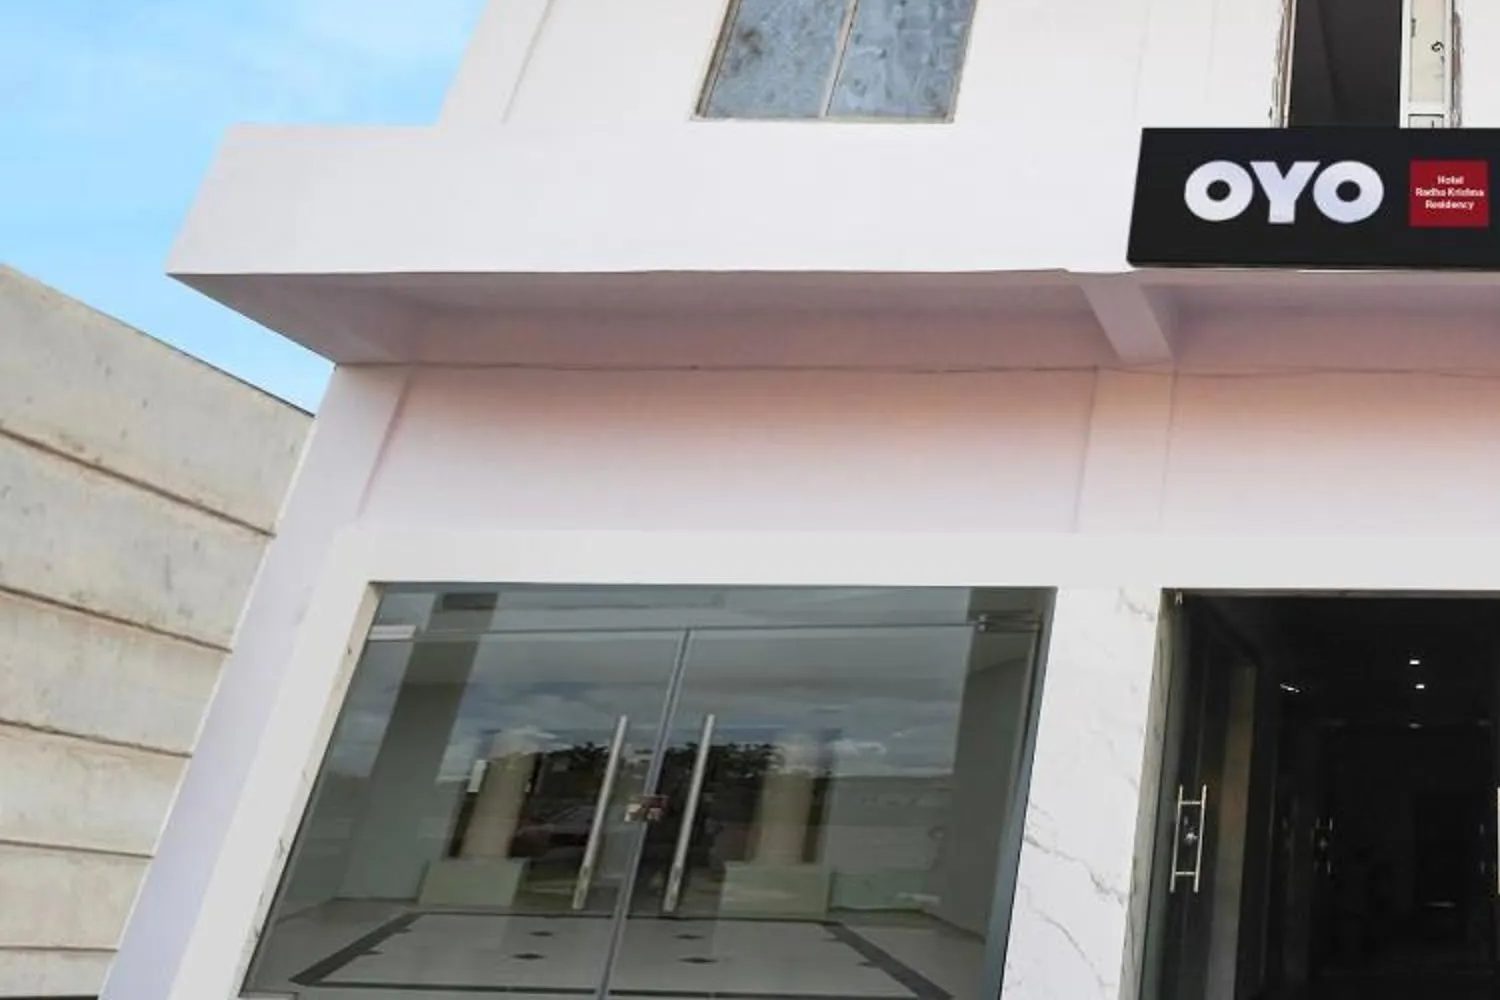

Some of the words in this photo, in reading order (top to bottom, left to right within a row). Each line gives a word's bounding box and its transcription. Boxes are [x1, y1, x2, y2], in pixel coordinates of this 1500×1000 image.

[1437, 175, 1464, 184] Hotel
[1184, 160, 1384, 223] OYO
[1415, 187, 1446, 196] Radha
[1447, 187, 1484, 196] Krishna
[1425, 199, 1474, 210] Residency
